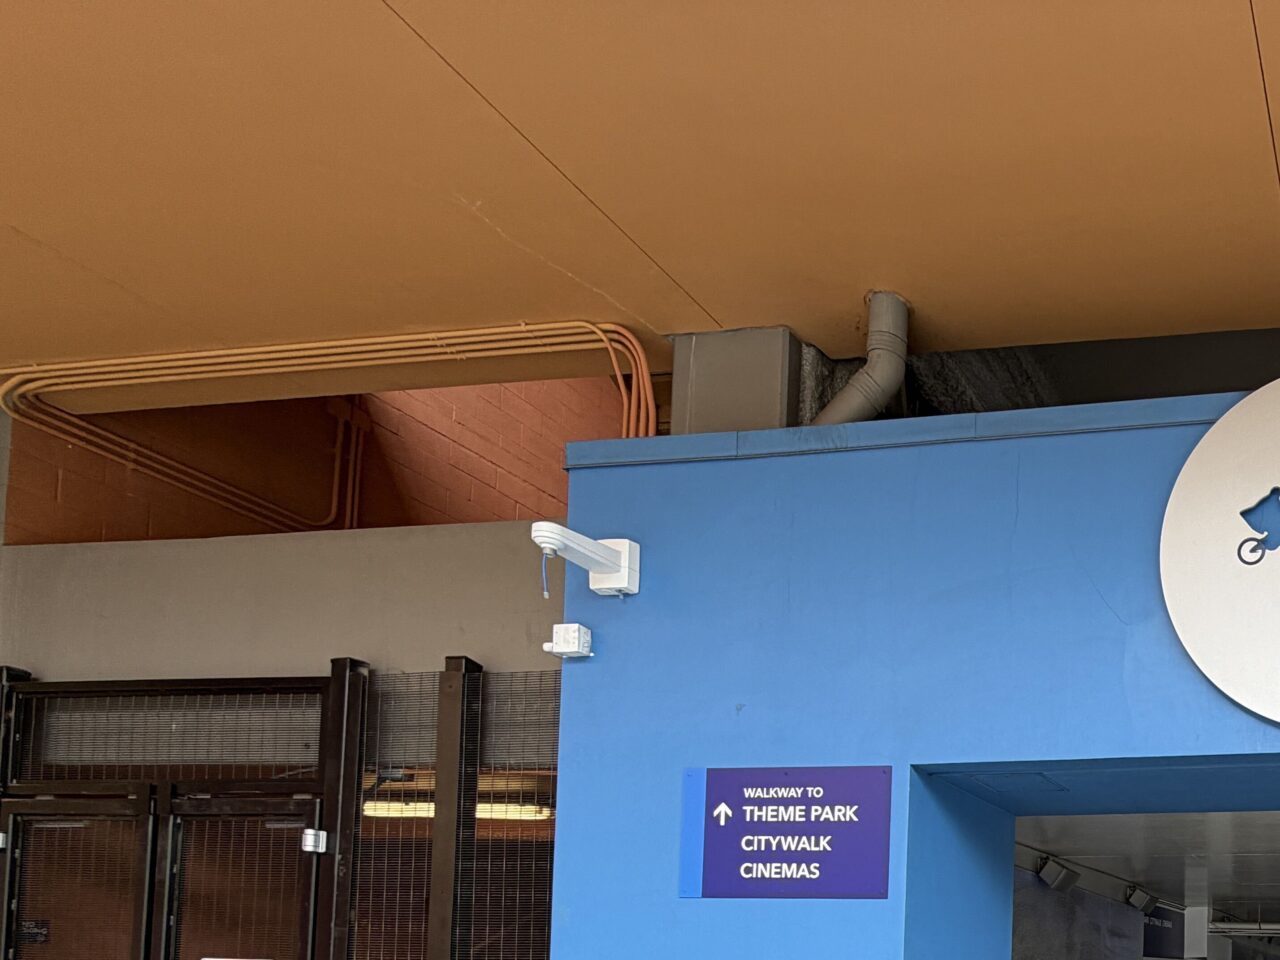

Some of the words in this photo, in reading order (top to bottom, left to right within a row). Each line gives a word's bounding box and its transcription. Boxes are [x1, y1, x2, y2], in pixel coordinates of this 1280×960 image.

[743, 787, 804, 799] WALKWAY
[806, 786, 824, 798] TO
[742, 805, 806, 822] THEME
[810, 805, 859, 822] PARK
[740, 835, 833, 851] CITYWALK
[739, 862, 821, 879] CINEMAS
